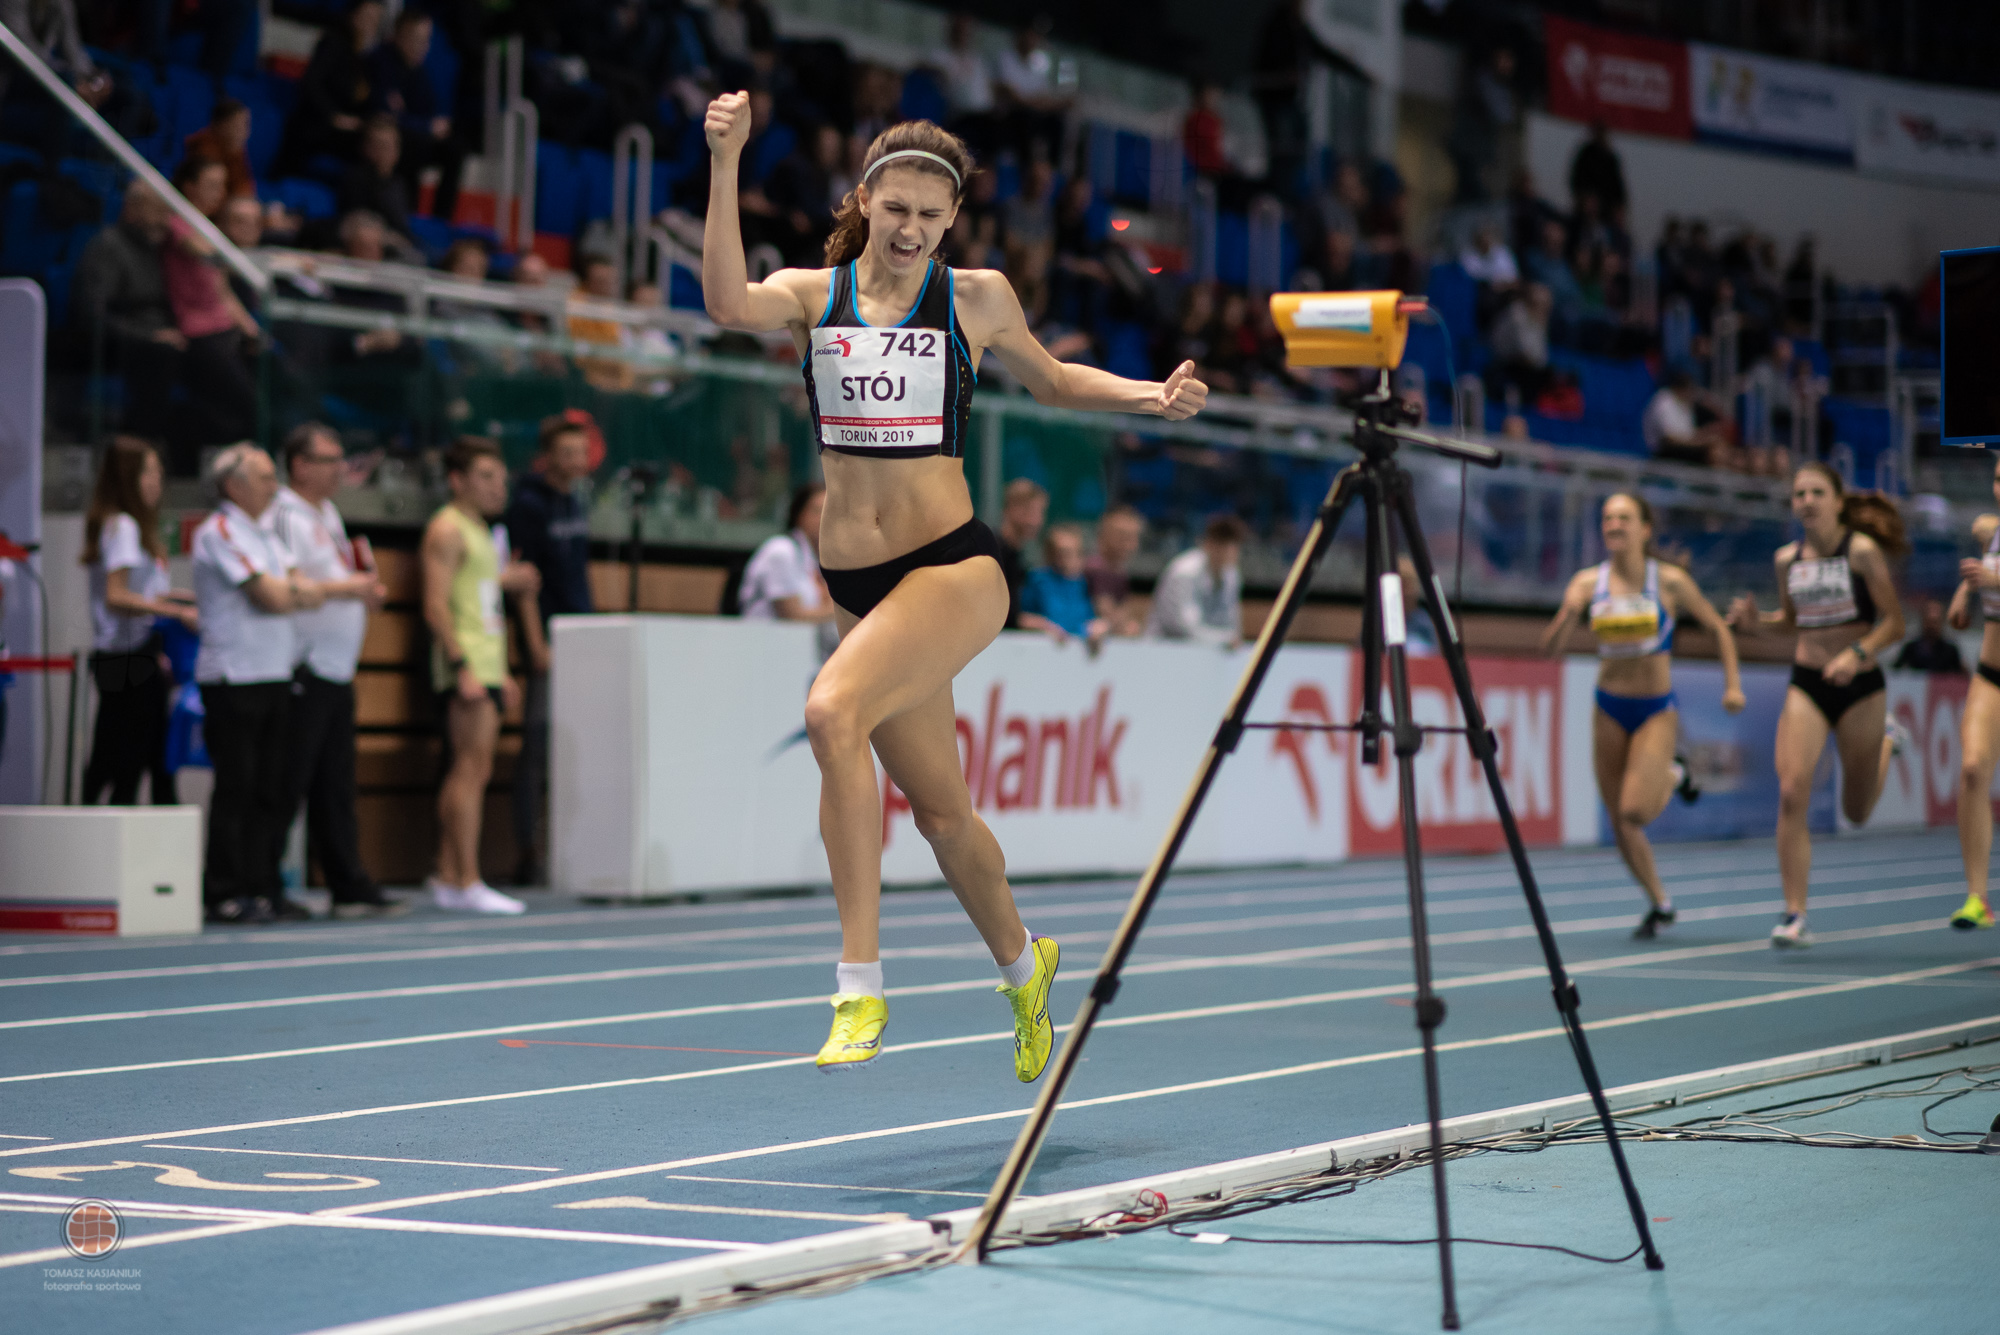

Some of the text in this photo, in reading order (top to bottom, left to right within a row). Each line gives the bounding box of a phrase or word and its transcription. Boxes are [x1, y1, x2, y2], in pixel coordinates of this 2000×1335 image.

[814, 347, 842, 357] polanik
[880, 332, 936, 357] 742
[841, 370, 906, 401] STÓJ
[841, 428, 914, 443] TORUŃ 2019
[1355, 684, 1553, 832] ORLEN
